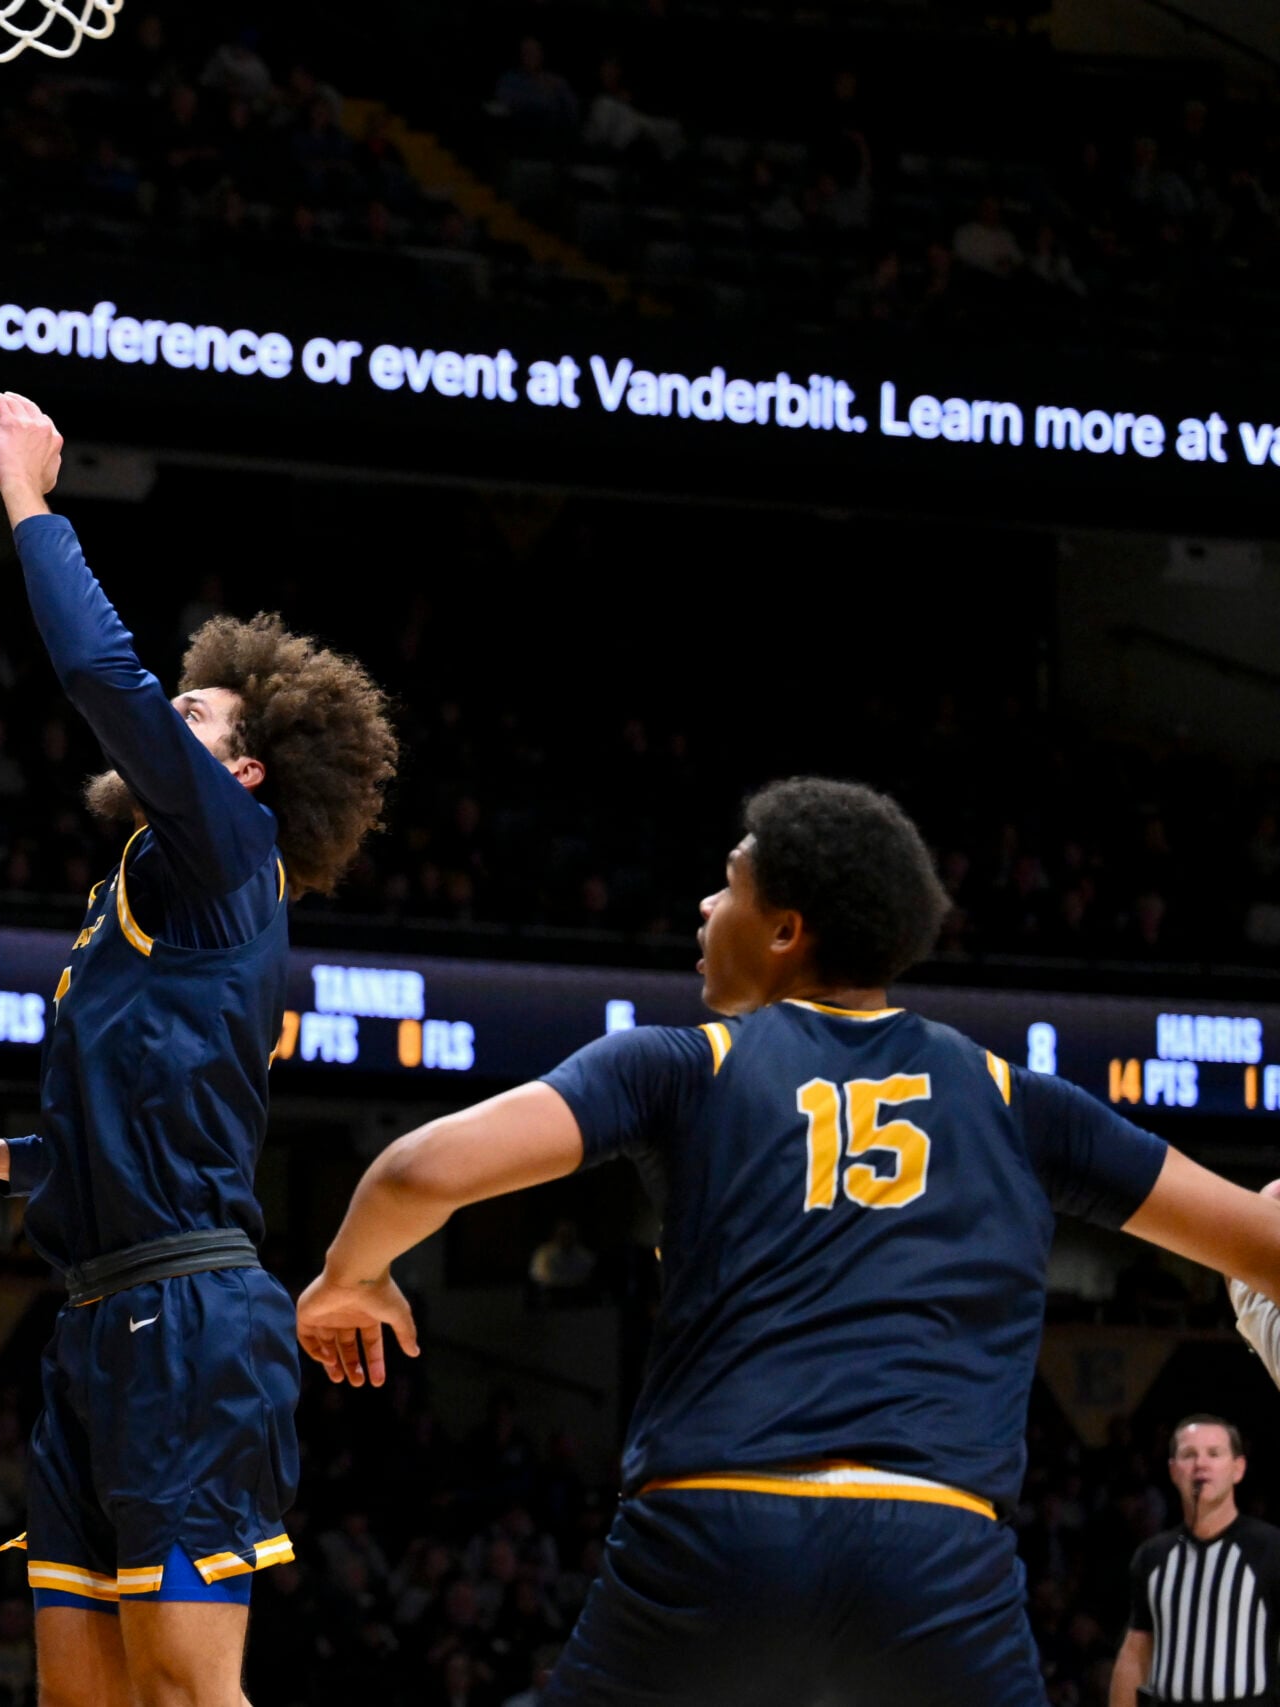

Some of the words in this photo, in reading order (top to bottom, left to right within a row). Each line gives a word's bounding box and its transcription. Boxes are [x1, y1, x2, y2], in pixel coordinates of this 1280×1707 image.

[302, 337, 363, 386] or
[368, 345, 519, 403] event
[525, 355, 582, 409] at
[589, 355, 868, 434] Vanderbilt.
[880, 381, 1024, 447] Learn
[1035, 405, 1166, 458] more
[1176, 411, 1229, 463] at
[311, 964, 425, 1019] TANNER
[300, 1010, 359, 1064] PTS
[397, 1018, 422, 1069] 0
[422, 1018, 475, 1071] FLS
[1027, 1022, 1057, 1074] 8
[1155, 1012, 1263, 1064] HARRIS
[1108, 1058, 1142, 1105] 14
[1143, 1058, 1199, 1108] PTS
[1244, 1065, 1258, 1110] 1
[796, 1071, 932, 1213] 15
